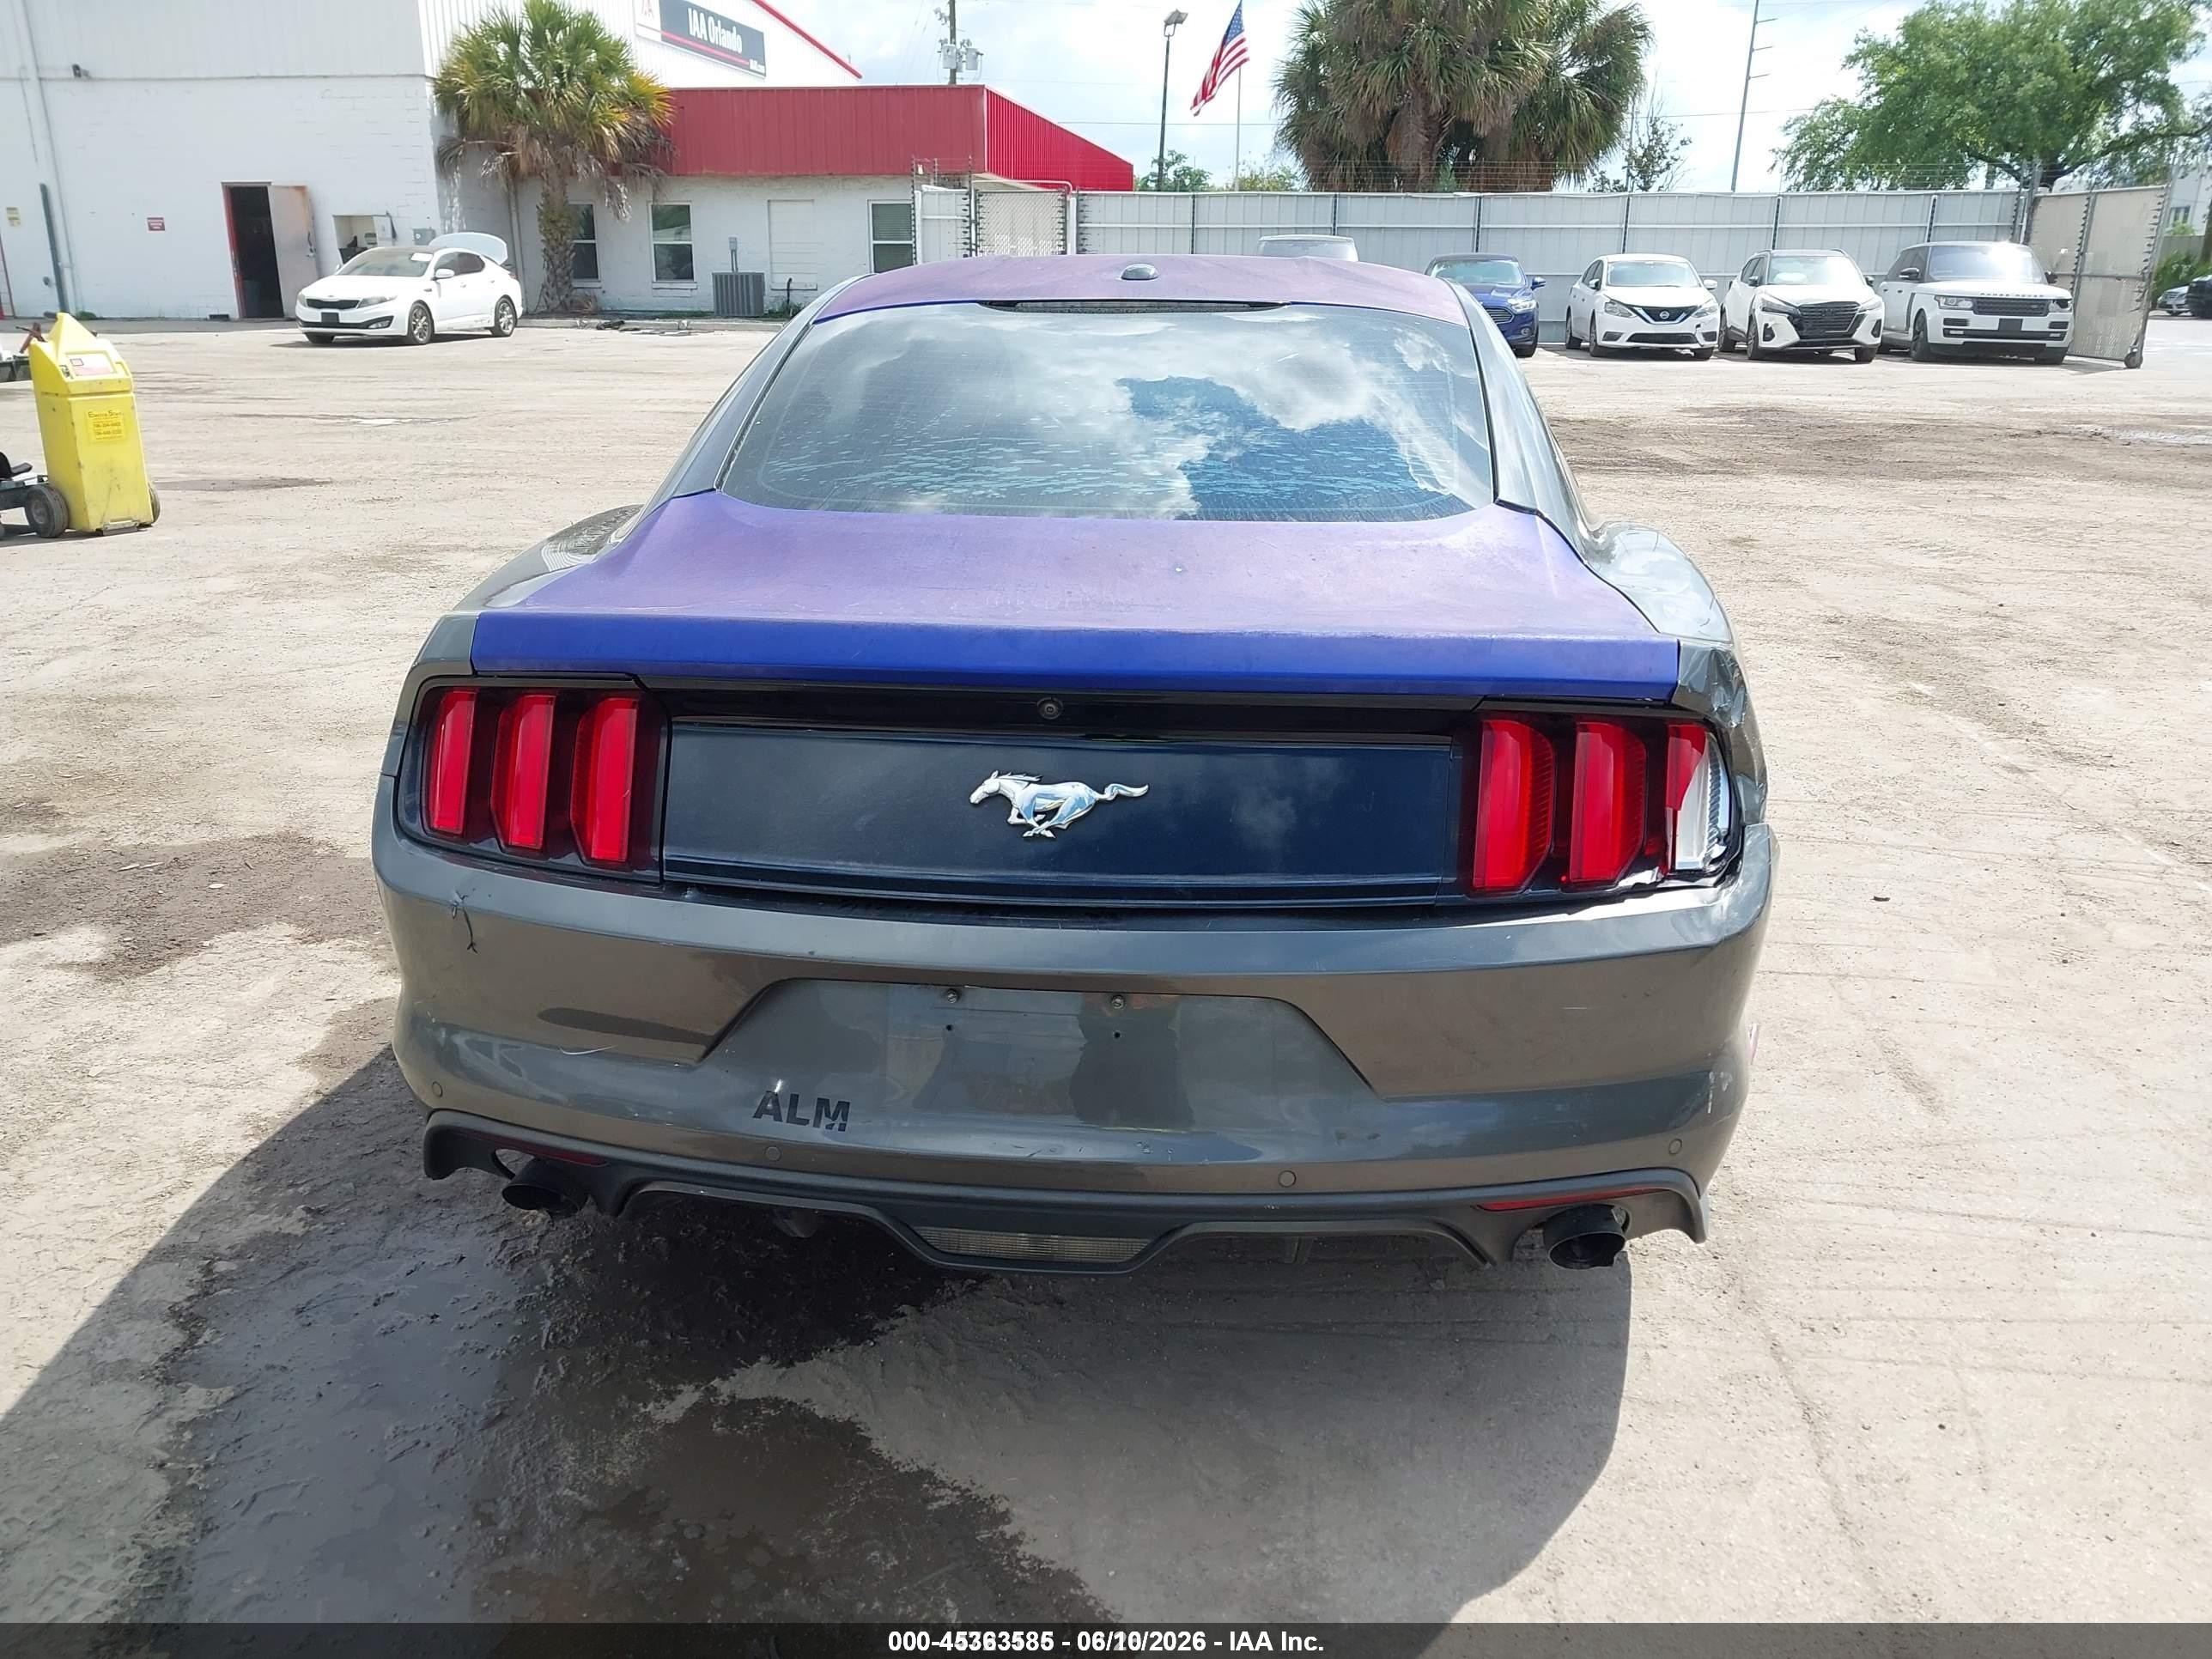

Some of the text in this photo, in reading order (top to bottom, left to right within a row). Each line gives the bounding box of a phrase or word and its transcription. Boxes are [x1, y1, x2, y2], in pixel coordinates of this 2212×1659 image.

[688, 8, 708, 41] IAA
[708, 15, 743, 54] Orlando
[752, 1091, 851, 1132] ALM
